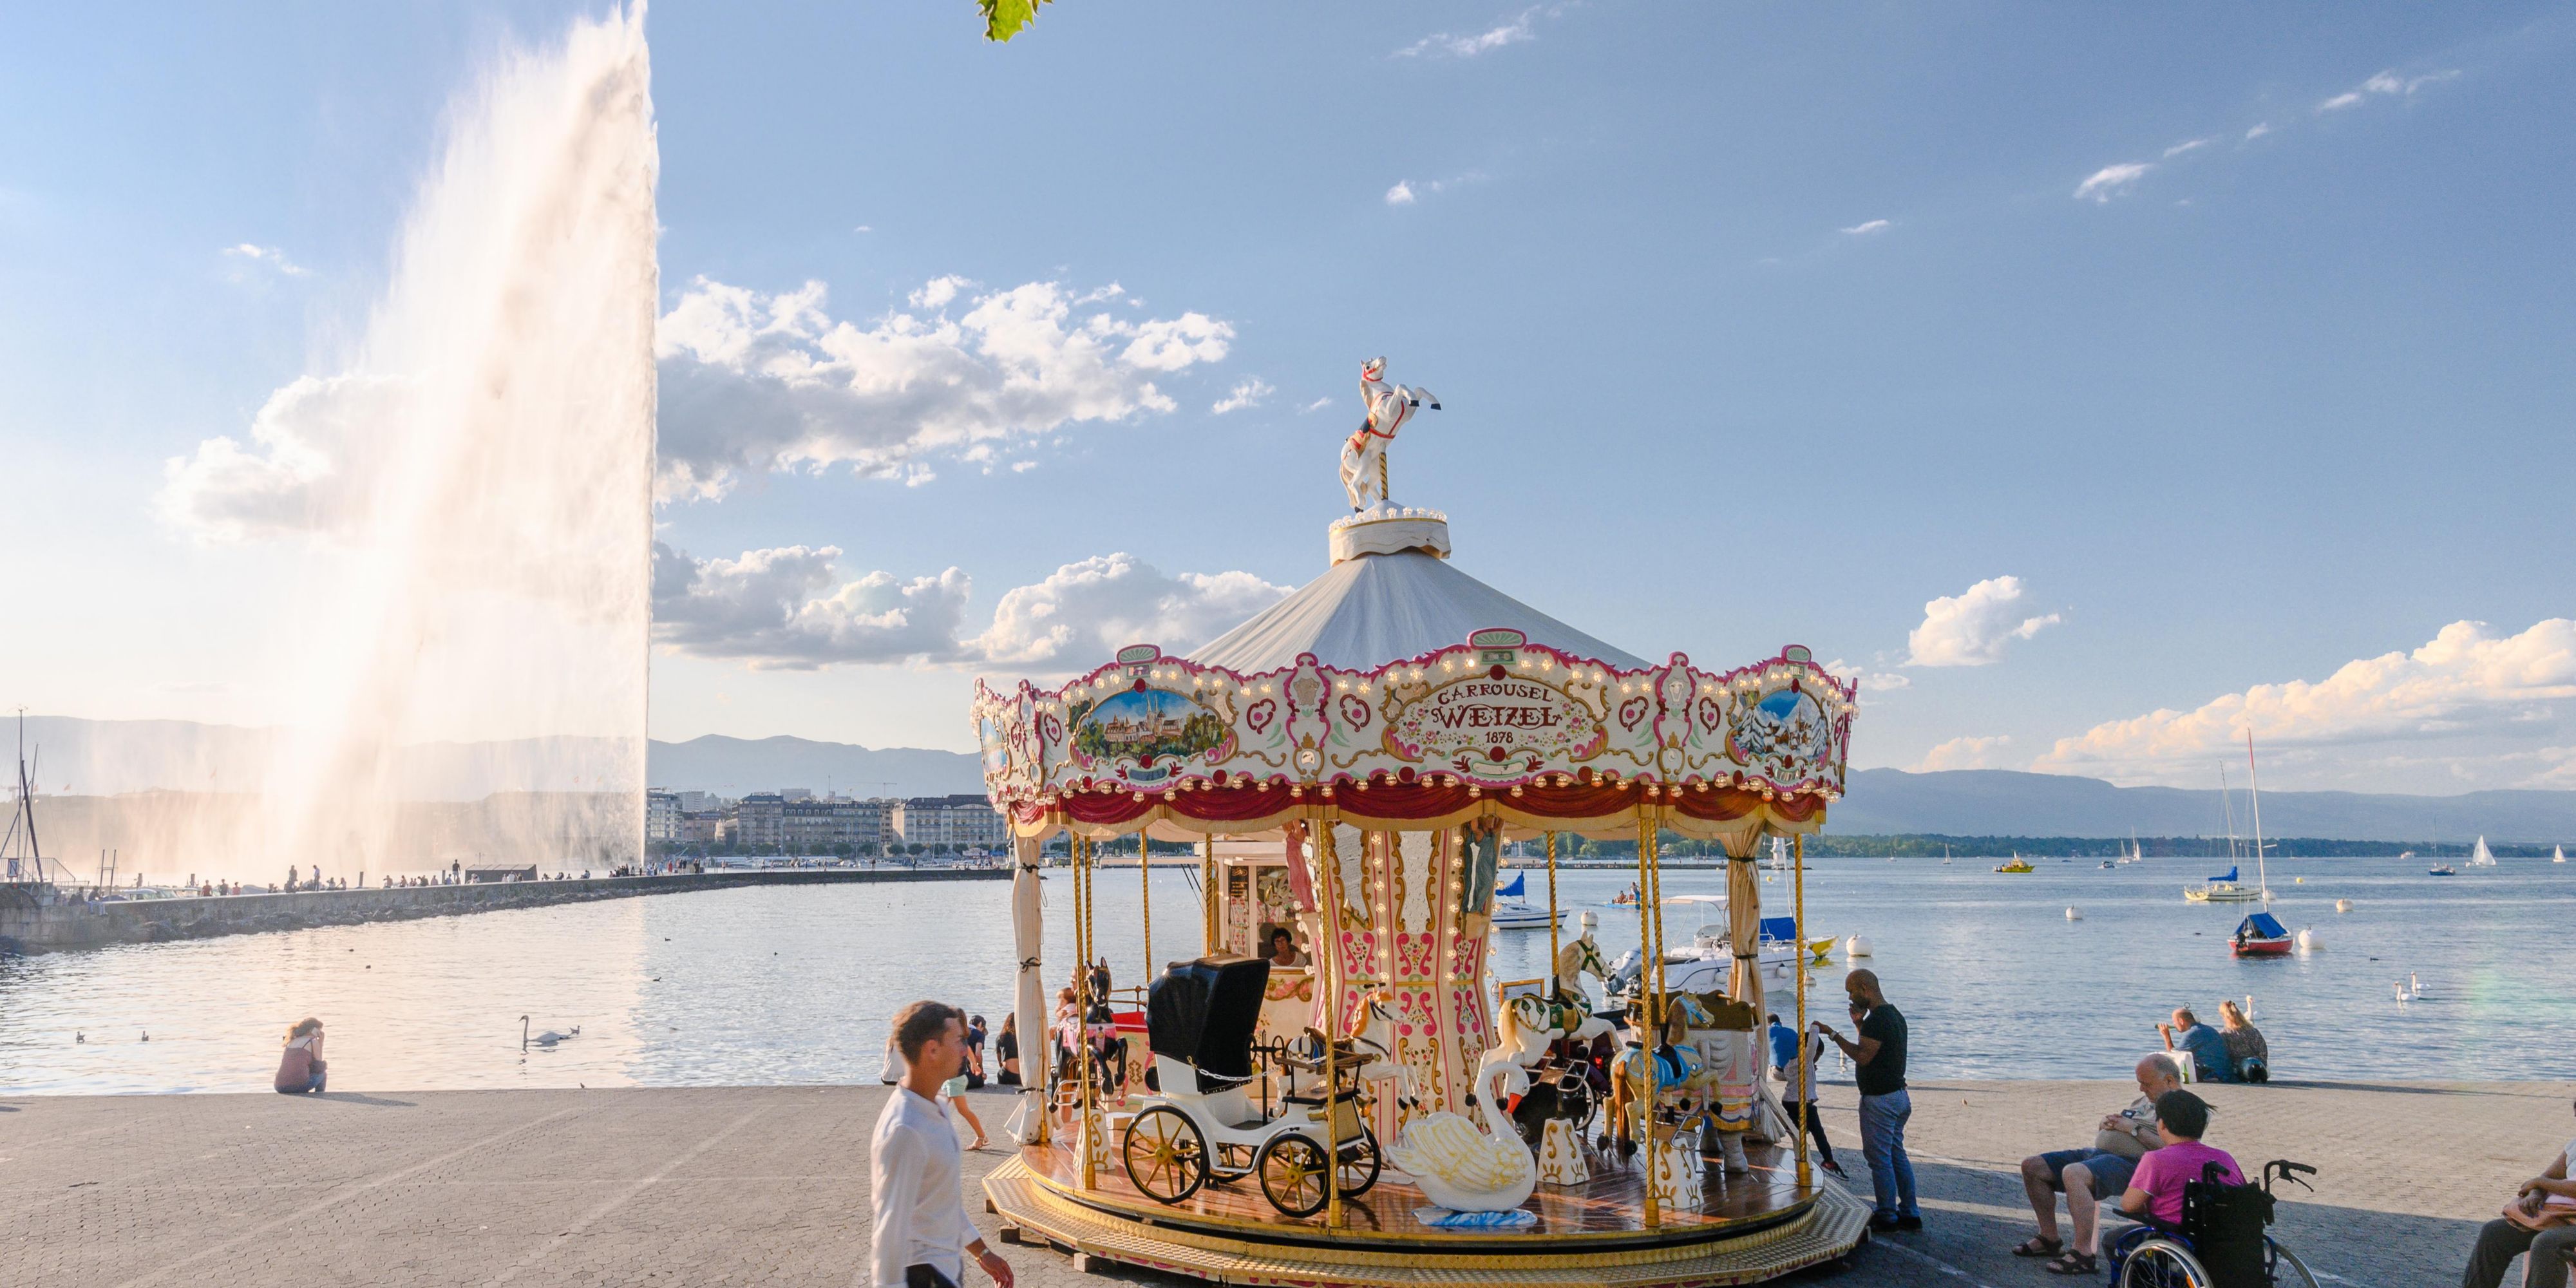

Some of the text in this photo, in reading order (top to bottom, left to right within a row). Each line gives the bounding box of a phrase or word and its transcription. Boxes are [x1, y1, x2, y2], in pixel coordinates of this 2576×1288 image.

[1437, 684, 1553, 705] CARROUSEL
[1432, 704, 1562, 730] WEIZEL
[1485, 732, 1513, 744] 1878
